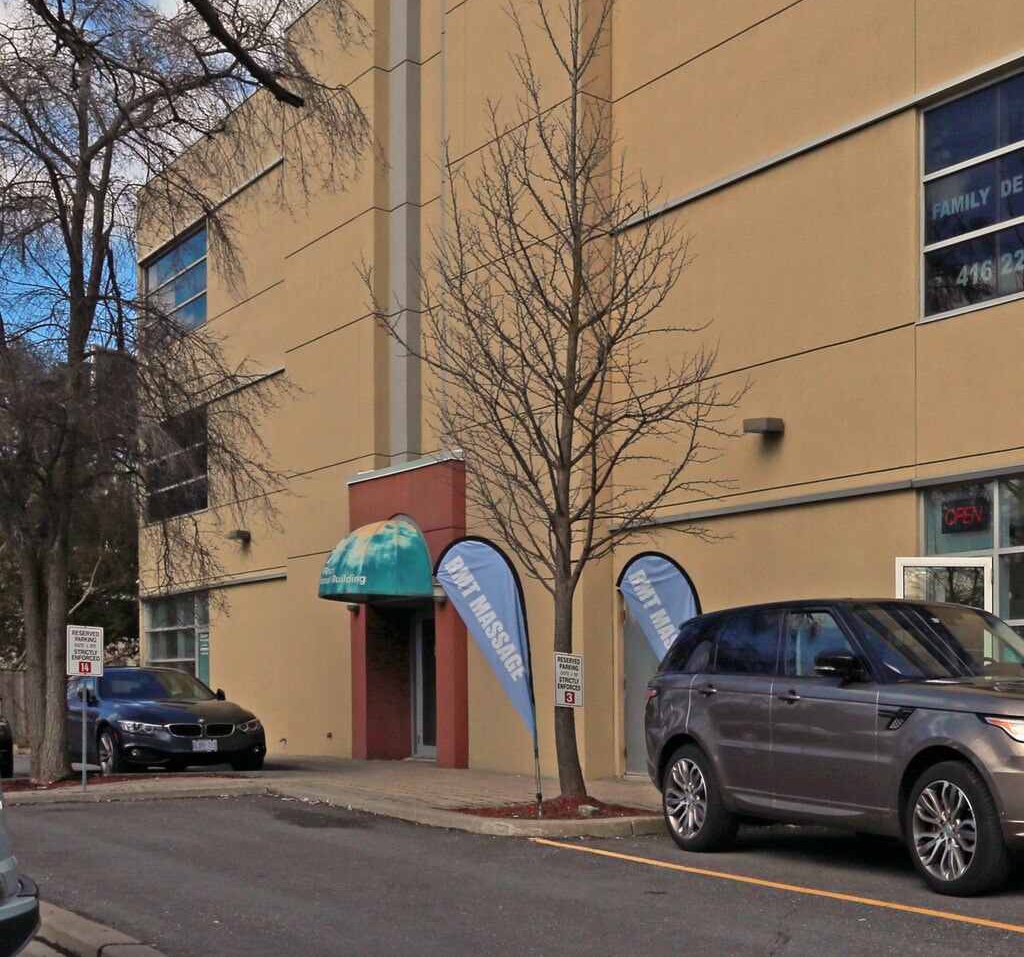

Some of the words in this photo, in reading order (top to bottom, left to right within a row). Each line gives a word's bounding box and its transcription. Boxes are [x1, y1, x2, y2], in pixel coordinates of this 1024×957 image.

[931, 187, 991, 220] FAMILY
[956, 259, 993, 288] 416
[945, 505, 984, 526] OPEN
[331, 574, 367, 586] Building
[627, 568, 662, 609] RMT
[444, 554, 482, 597] RMT
[468, 594, 528, 682] MASSAGE
[72, 630, 100, 638] RESERVED
[557, 656, 580, 664] RESERVED
[81, 662, 90, 672] 14
[557, 683, 581, 691] ENFORCED
[566, 693, 573, 702] 3
